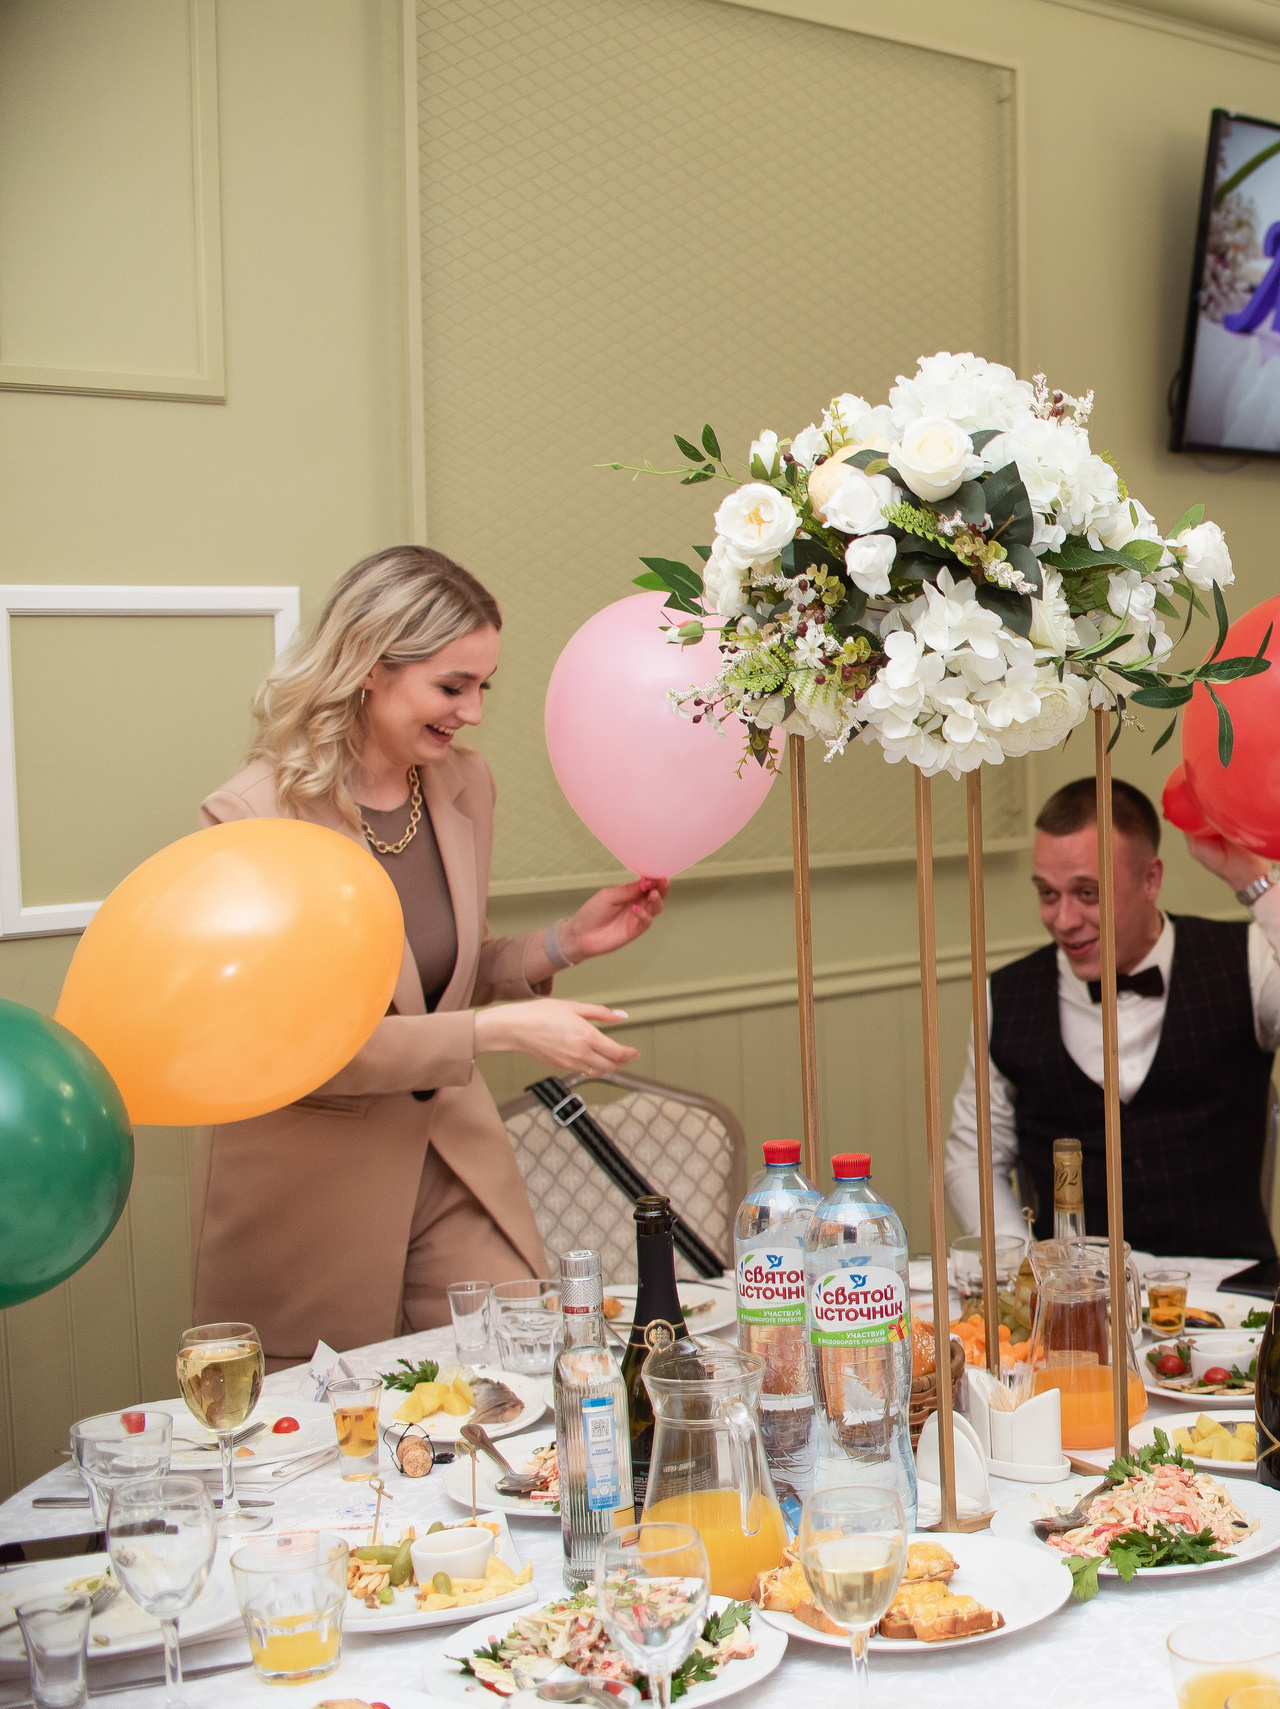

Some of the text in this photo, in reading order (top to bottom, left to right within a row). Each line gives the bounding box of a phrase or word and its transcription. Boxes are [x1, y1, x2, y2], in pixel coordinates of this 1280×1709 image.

[823, 1284, 895, 1305] СВЯТОЙ
[763, 1308, 801, 1317] УЧАСТВУЙ
[815, 1300, 903, 1322] ИСТОЧНИК
[846, 1329, 885, 1339] УЧАСТВУЙ
